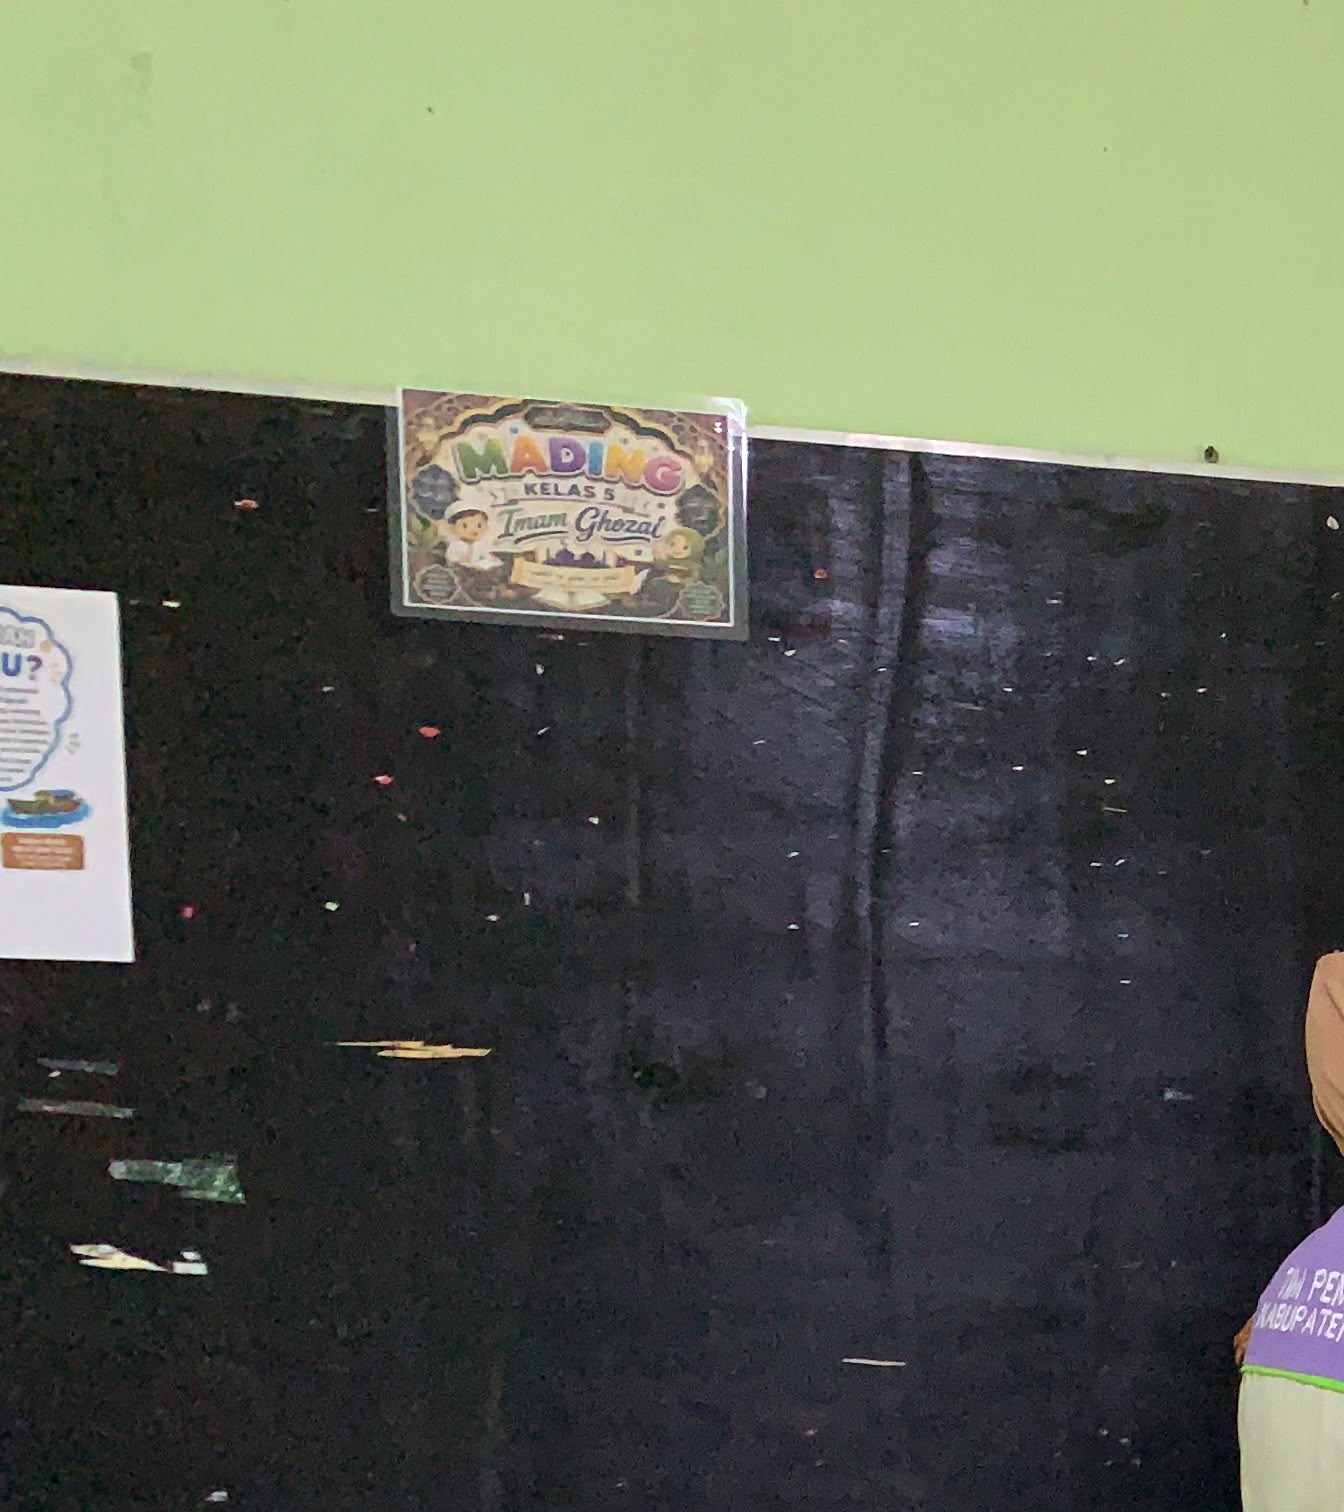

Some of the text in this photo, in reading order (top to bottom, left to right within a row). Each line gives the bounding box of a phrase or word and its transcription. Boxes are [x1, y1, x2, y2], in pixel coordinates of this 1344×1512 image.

[453, 434, 685, 494] MADING
[524, 482, 615, 501] KELAS 5
[497, 507, 568, 539] Imam
[0, 652, 43, 681] U?
